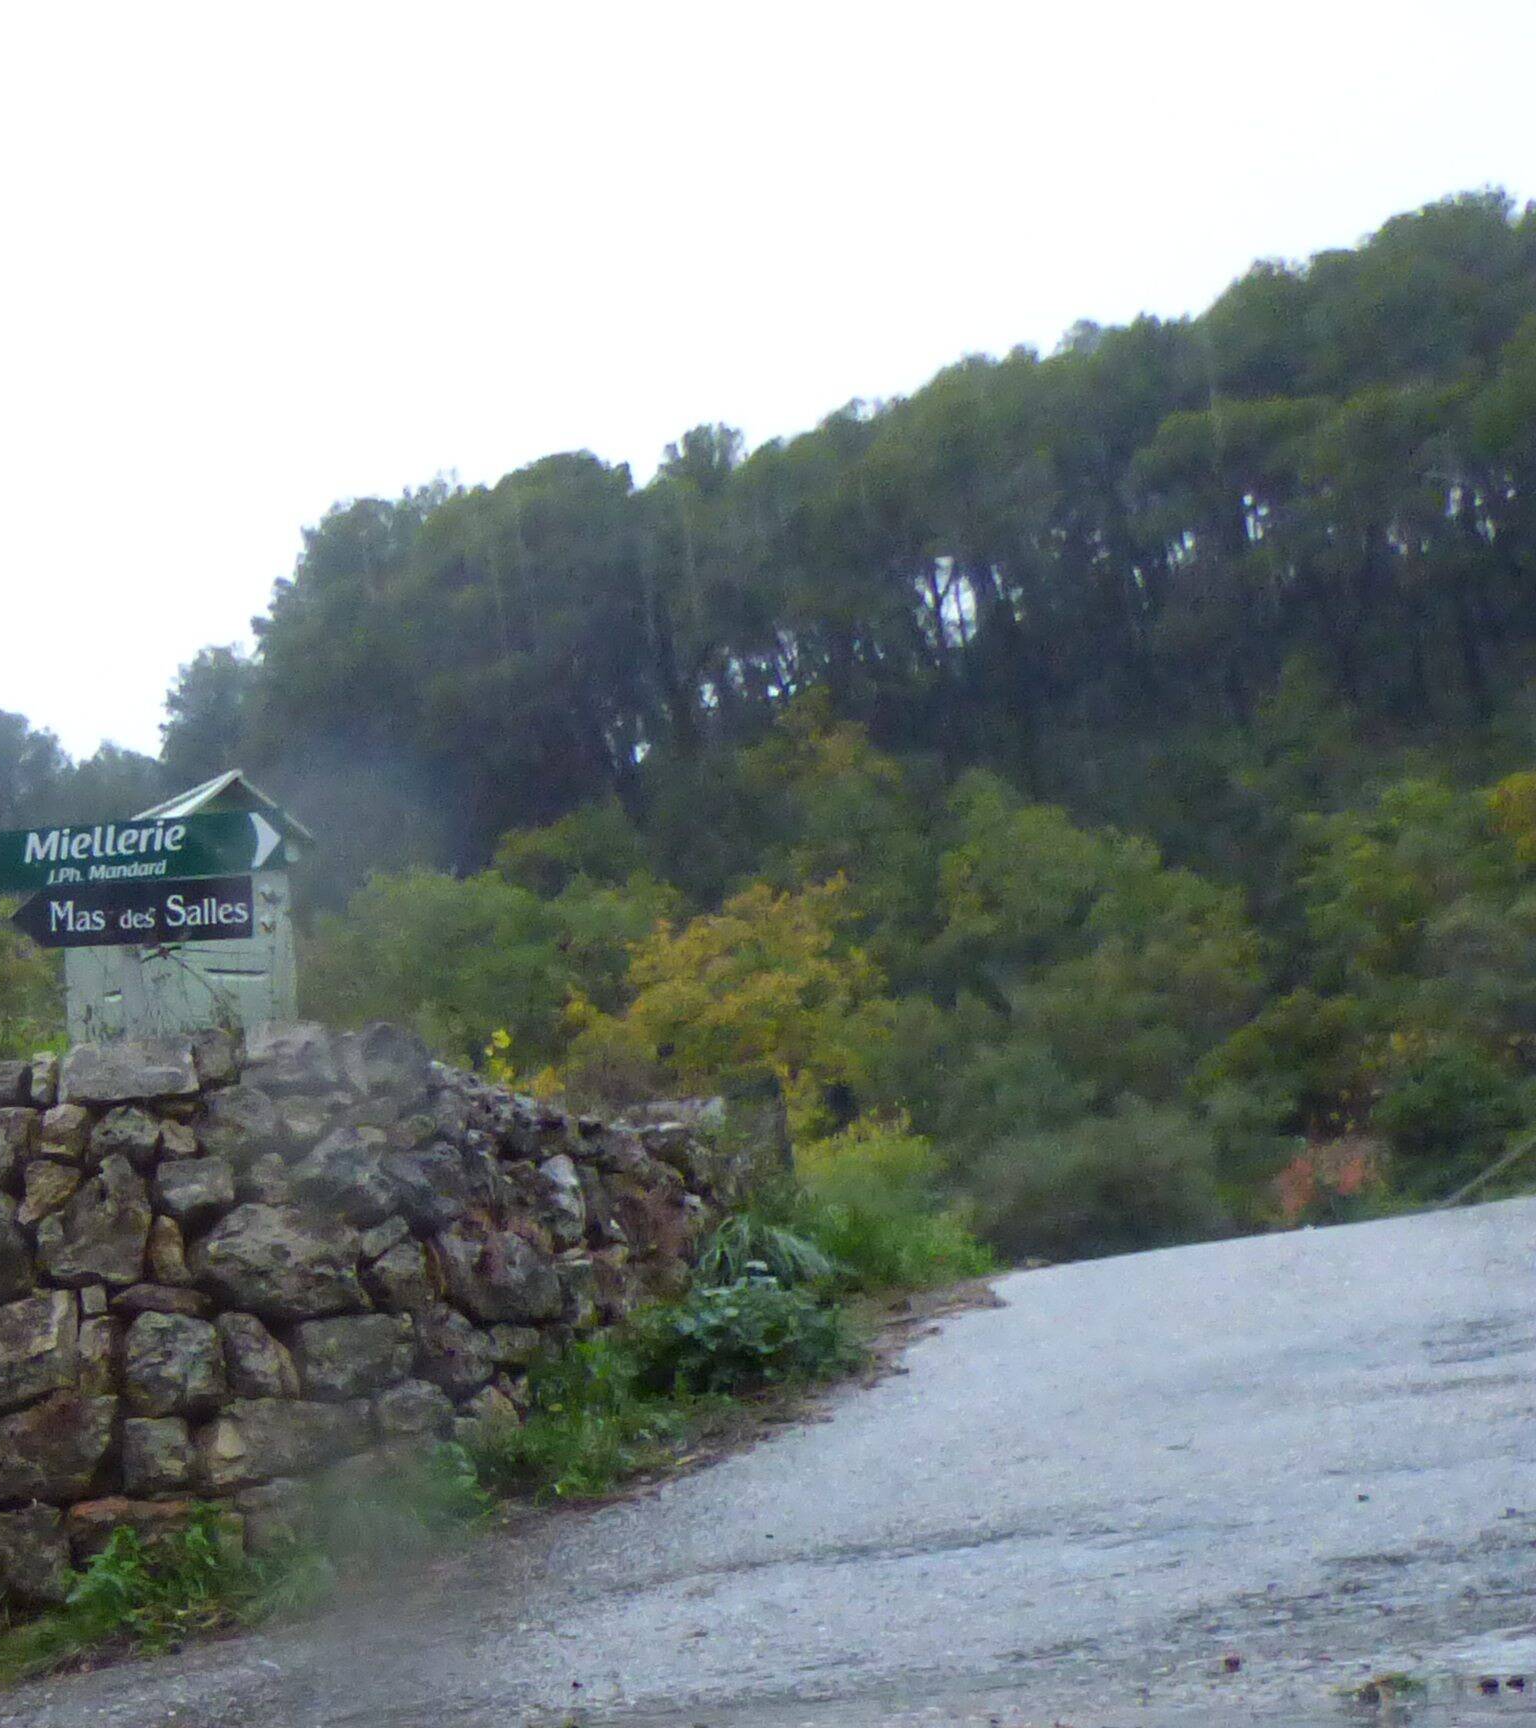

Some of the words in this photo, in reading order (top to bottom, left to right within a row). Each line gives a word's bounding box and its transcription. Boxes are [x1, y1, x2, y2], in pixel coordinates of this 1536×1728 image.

[24, 821, 187, 864] Miellerie
[89, 859, 167, 880] Mandard
[49, 901, 107, 932] Mas
[120, 908, 155, 930] des
[166, 895, 249, 927] Salles
